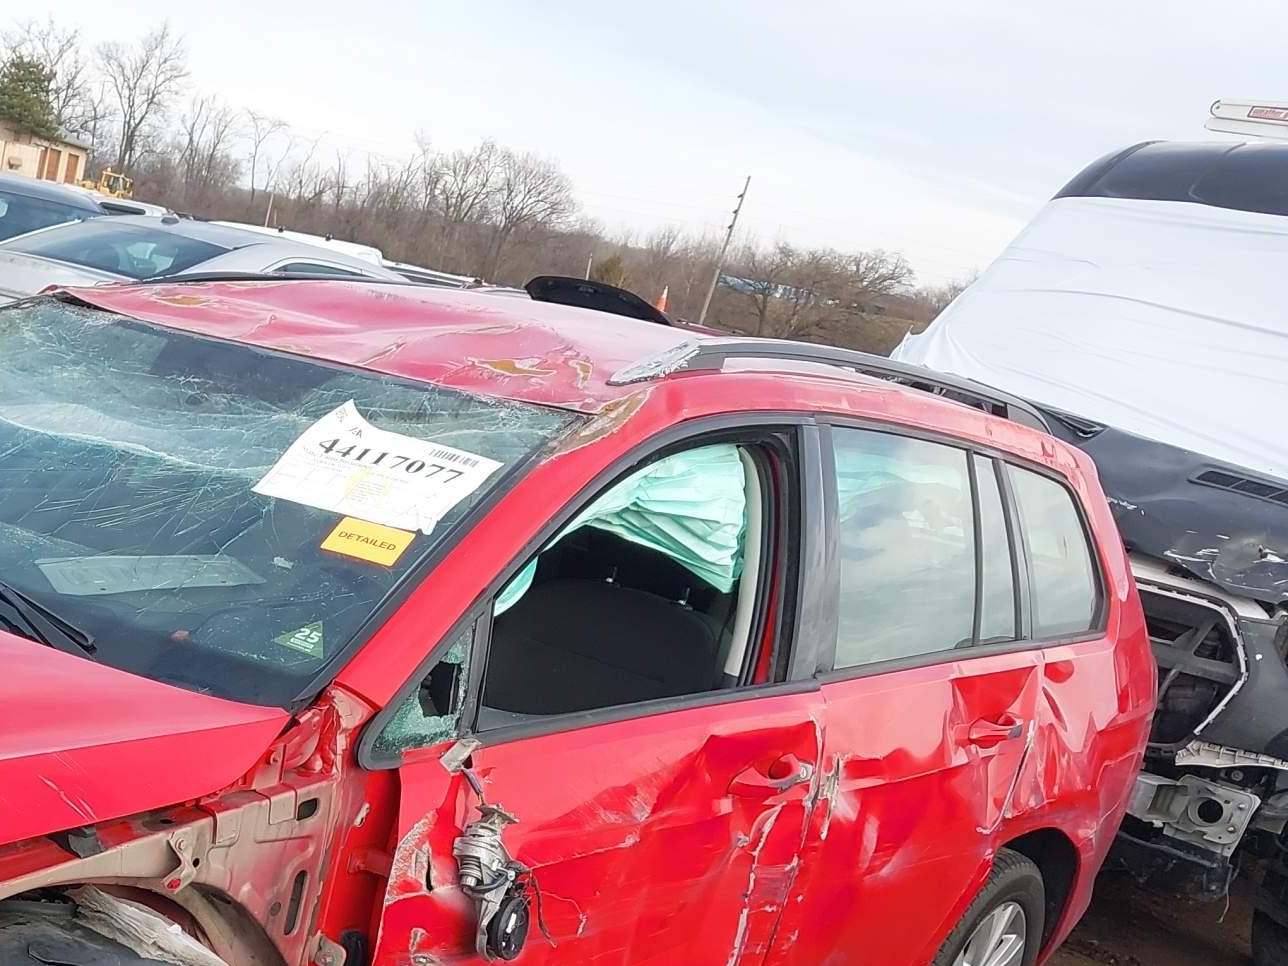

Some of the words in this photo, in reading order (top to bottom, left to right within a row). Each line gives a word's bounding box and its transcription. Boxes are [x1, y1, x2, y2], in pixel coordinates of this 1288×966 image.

[319, 438, 464, 484] 44117077
[338, 531, 397, 551] DETAILED
[294, 627, 322, 643] 25
